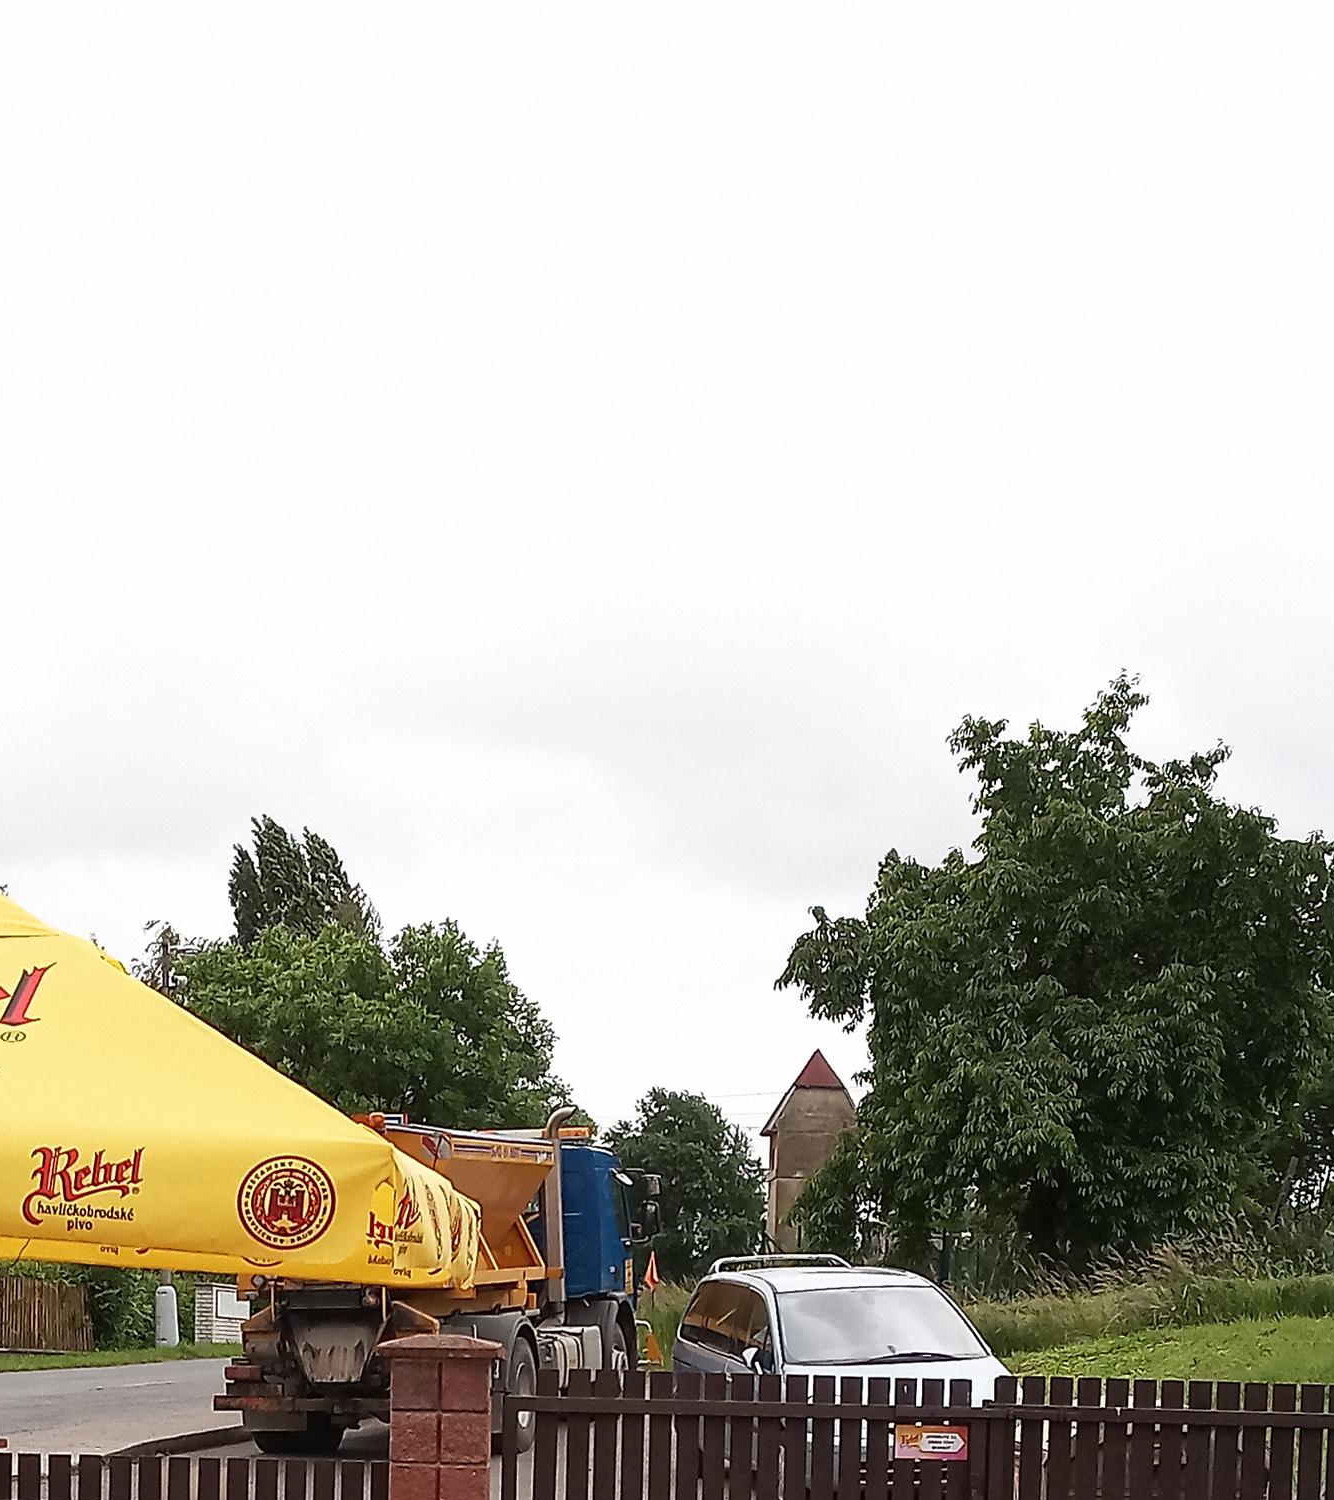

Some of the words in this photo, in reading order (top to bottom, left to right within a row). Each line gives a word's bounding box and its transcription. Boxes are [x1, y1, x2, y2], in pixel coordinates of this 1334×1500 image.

[22, 1146, 145, 1225] Rebel
[37, 1200, 135, 1221] havlíčkobrodské
[67, 1217, 94, 1231] pivo
